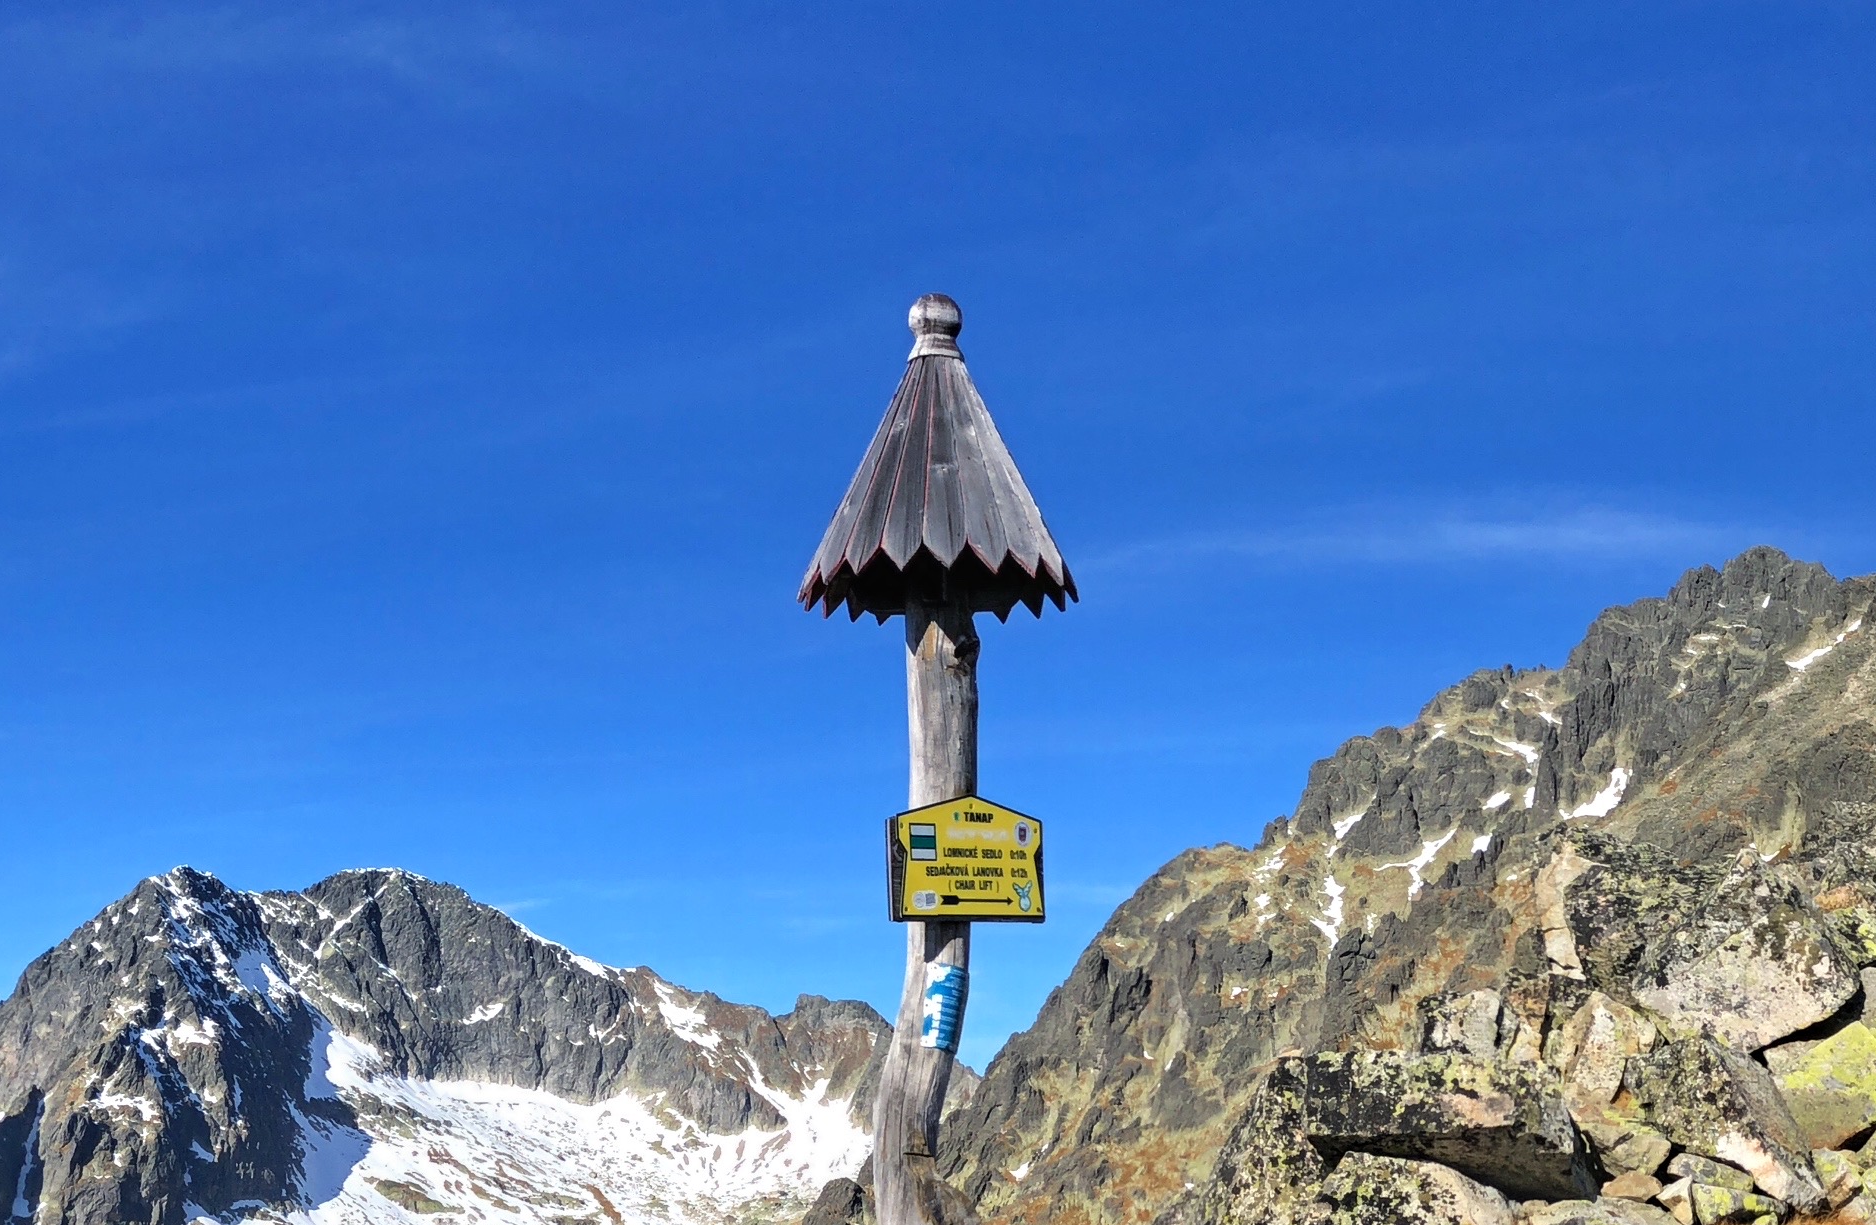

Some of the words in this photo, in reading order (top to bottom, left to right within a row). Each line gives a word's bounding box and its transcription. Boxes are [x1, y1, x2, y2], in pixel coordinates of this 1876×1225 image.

[963, 812, 994, 823] TANAP
[943, 846, 978, 859] LOMNICKÉ
[981, 849, 1003, 860] SEDLO
[1010, 850, 1027, 860] 0:10h
[972, 866, 1004, 877] LANOVKA
